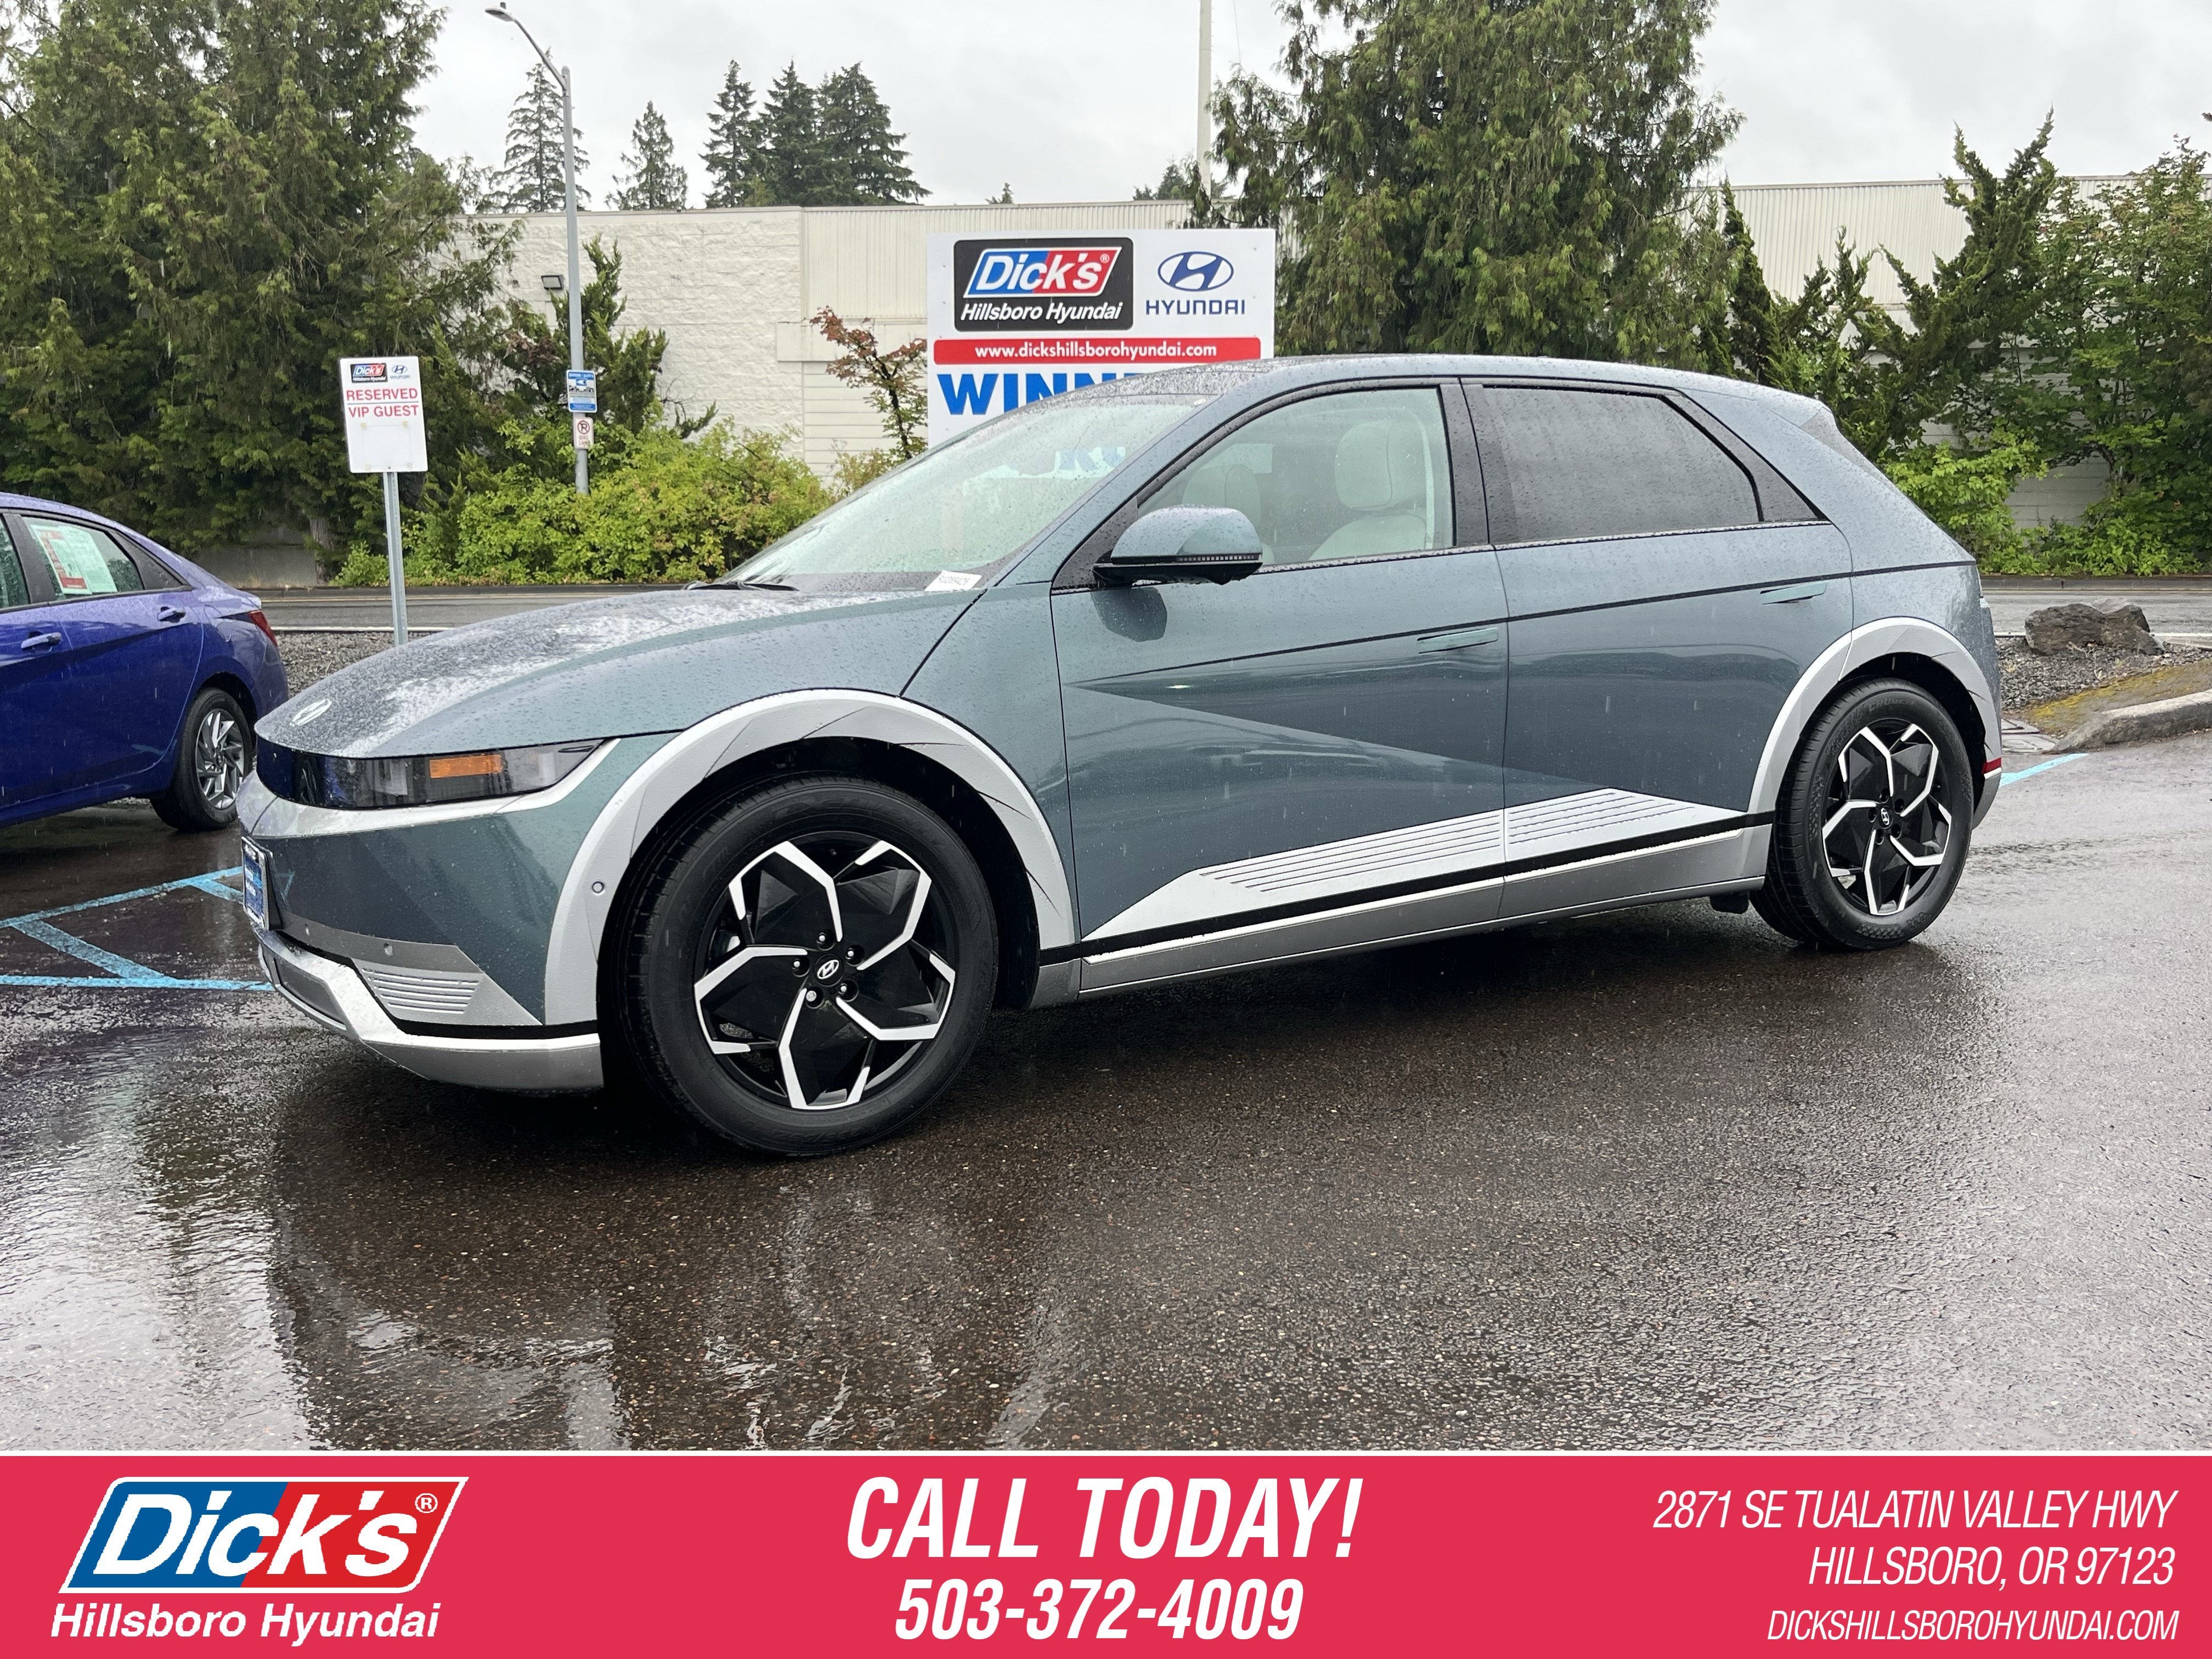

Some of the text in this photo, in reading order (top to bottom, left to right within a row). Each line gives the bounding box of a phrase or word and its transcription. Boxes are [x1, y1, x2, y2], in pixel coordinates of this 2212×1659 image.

[975, 252, 1102, 291] Dick's
[960, 302, 1124, 324] Hillsboro Hyundai
[1147, 300, 1245, 315] HYUNDAI
[975, 341, 1217, 361] www.dickshillsborohyundai.com
[346, 388, 418, 401] RESERVED
[936, 373, 1148, 415] WIN
[349, 405, 419, 417] VIP GUEST
